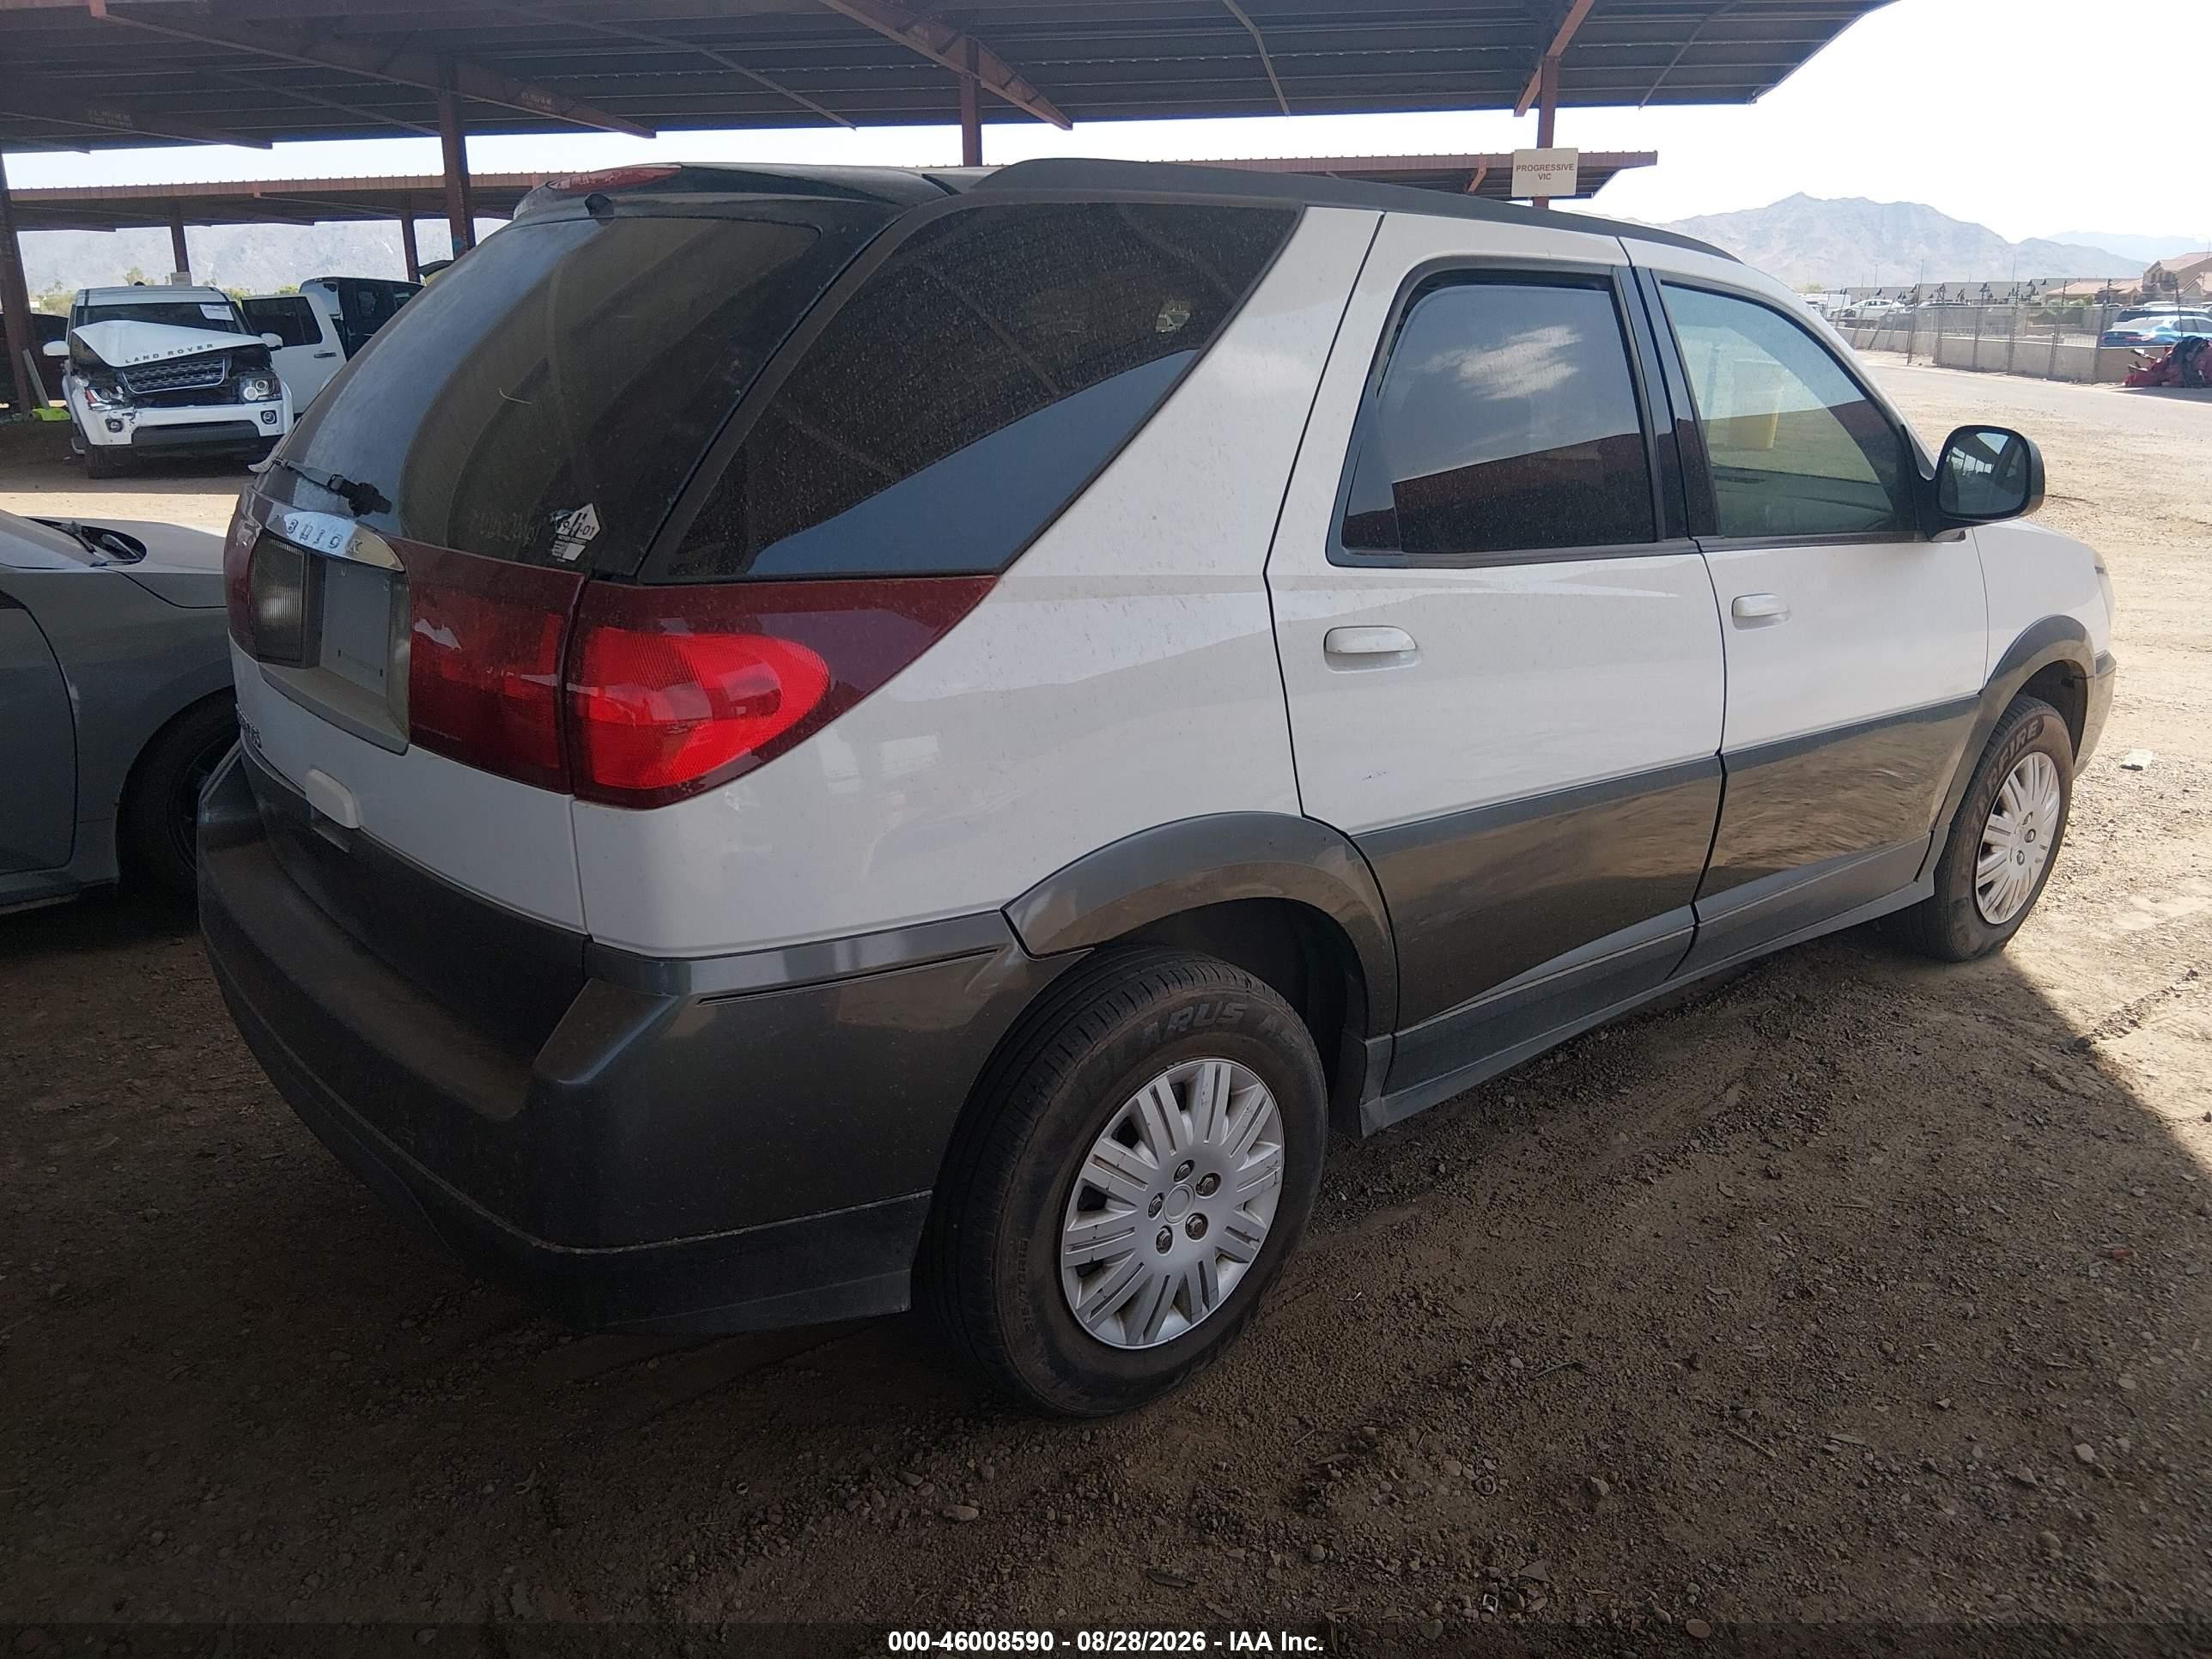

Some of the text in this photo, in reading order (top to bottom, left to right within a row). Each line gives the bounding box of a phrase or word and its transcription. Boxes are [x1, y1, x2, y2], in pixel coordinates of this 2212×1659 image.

[1516, 163, 1574, 172] PROGRESSIVE
[125, 343, 214, 364] LAND ROVER
